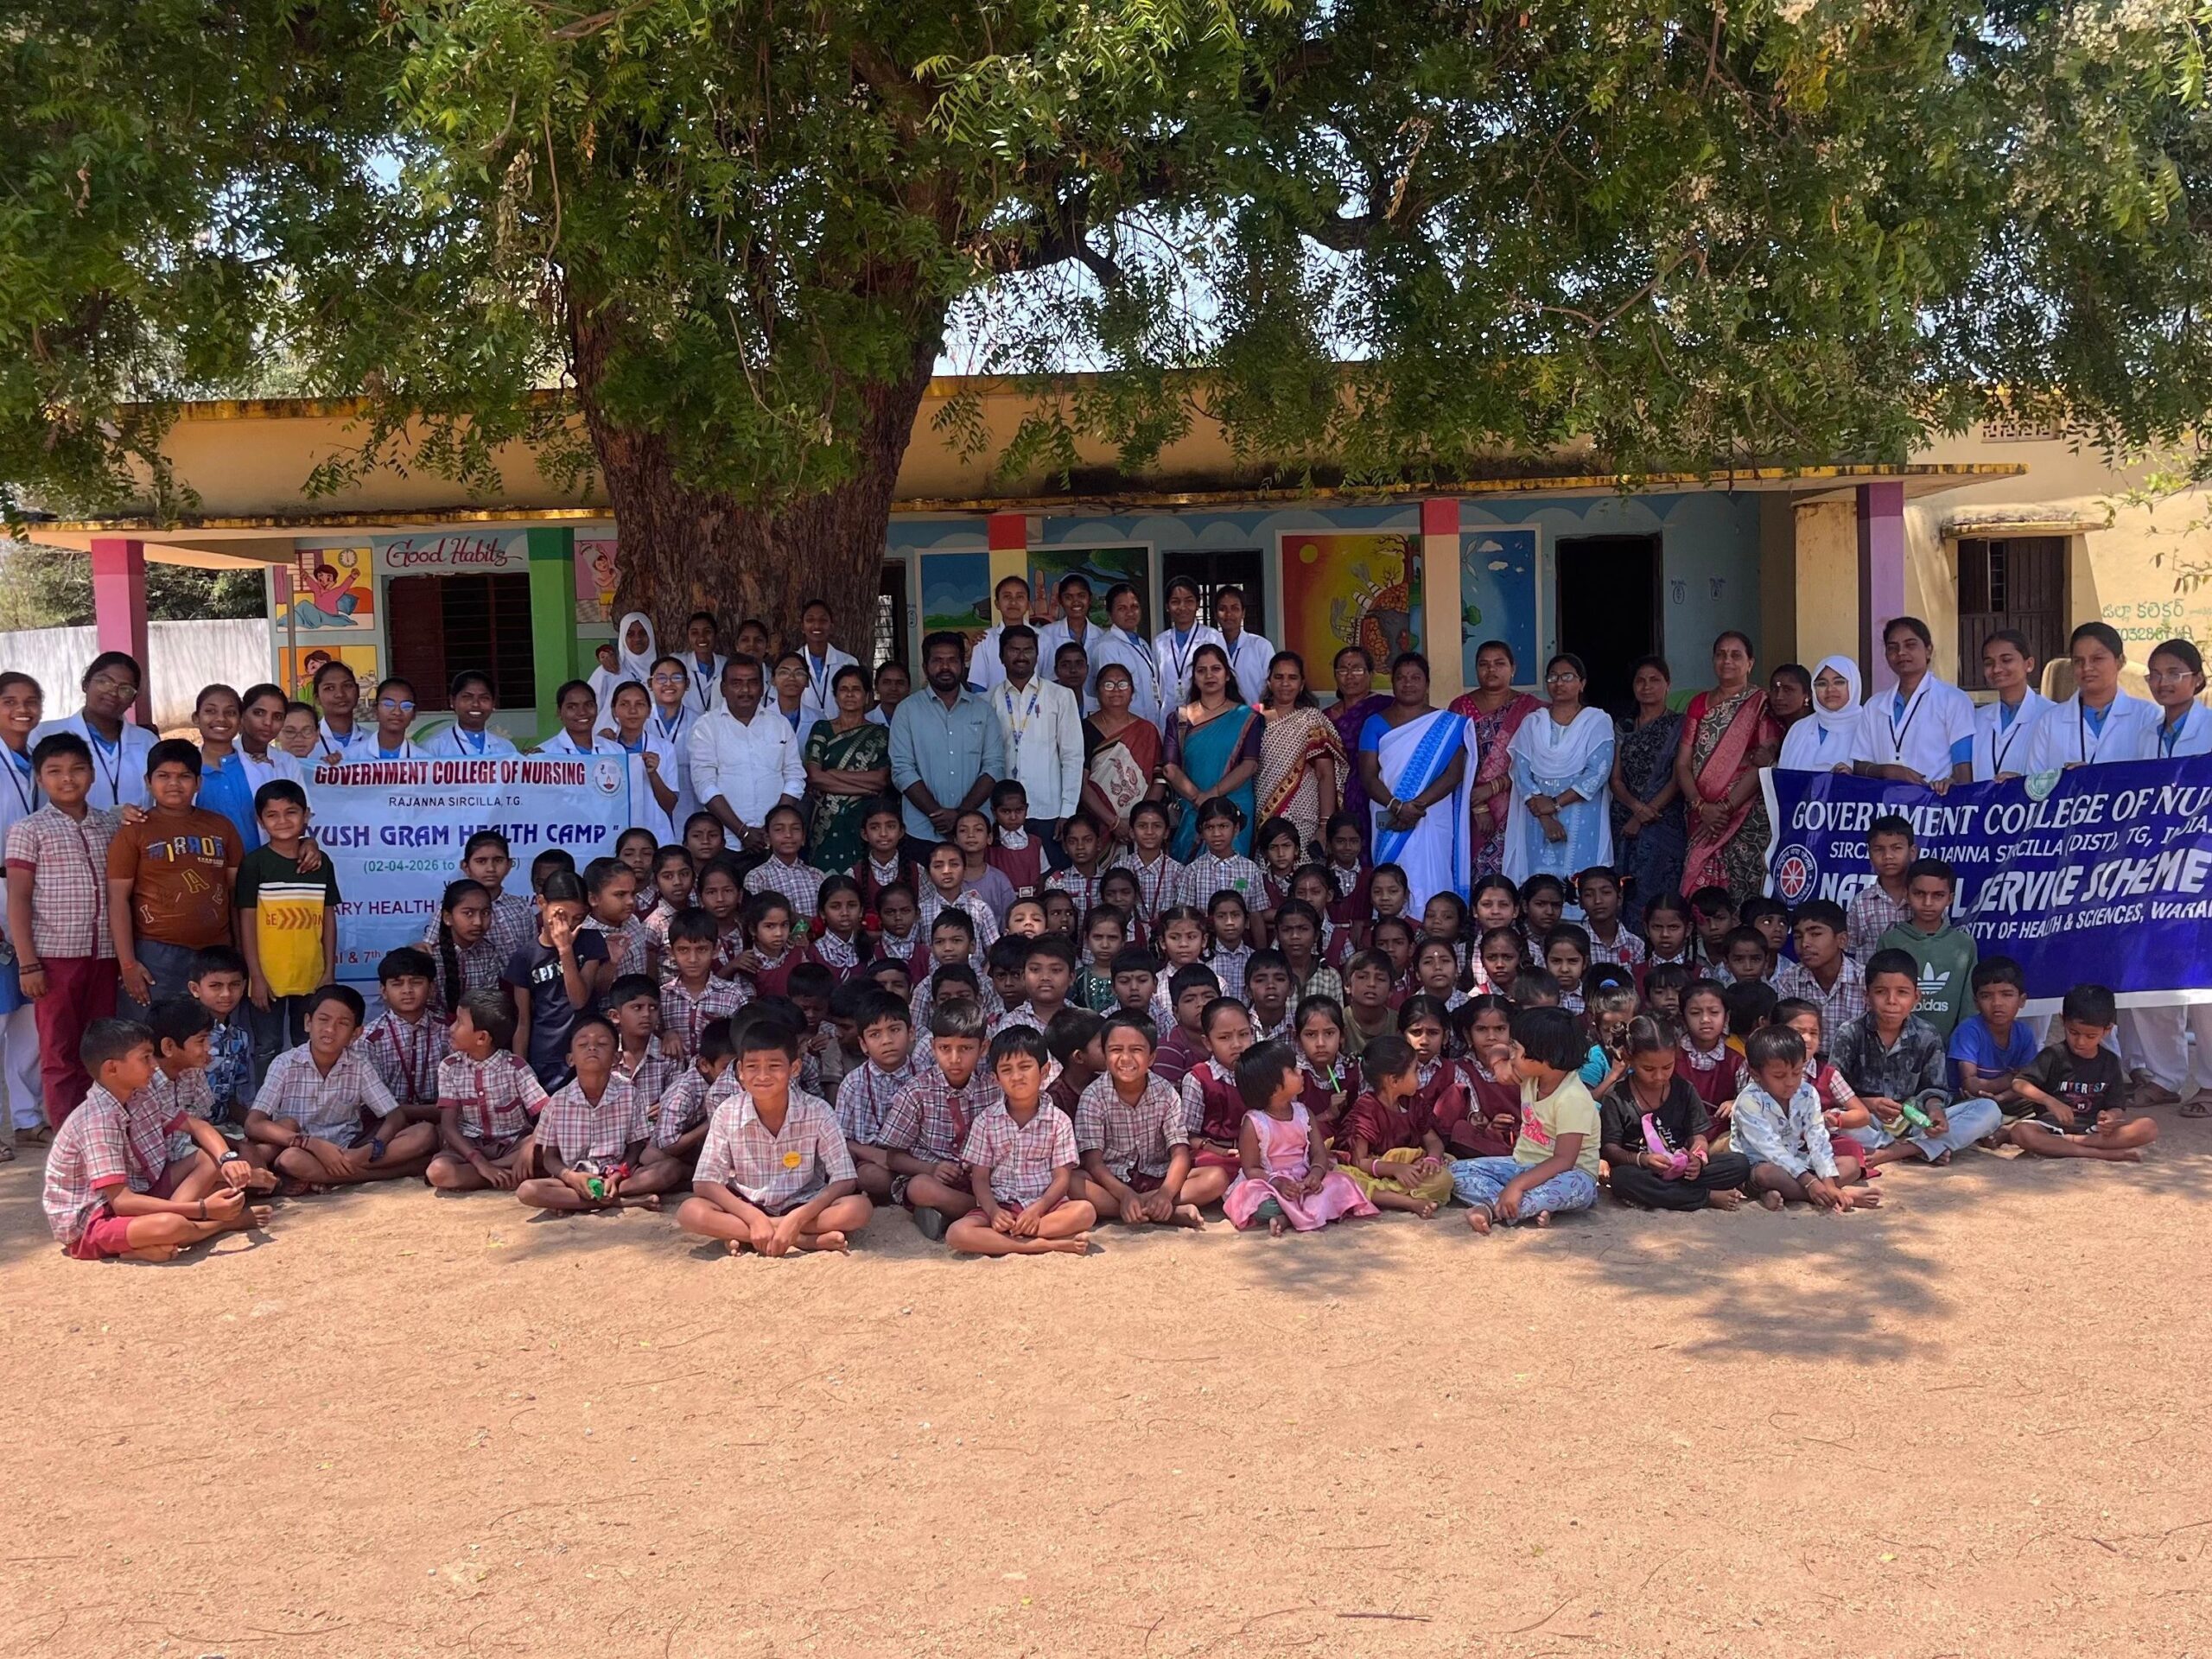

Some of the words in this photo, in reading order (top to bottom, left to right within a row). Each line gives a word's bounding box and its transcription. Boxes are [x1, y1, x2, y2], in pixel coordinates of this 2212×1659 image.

[386, 537, 447, 568] Good
[450, 536, 524, 567] Habits
[315, 760, 429, 785] GOVERNMENT
[432, 760, 497, 785] COLLEGE
[501, 760, 518, 785] OF
[521, 761, 586, 785] NURSING
[389, 797, 445, 807] RAJANNA
[2112, 787, 2154, 822] OF
[379, 825, 449, 849] GRAM
[546, 823, 606, 845] CAMP
[2126, 826, 2153, 847] TG,
[363, 860, 439, 874] (02-04-2026
[442, 861, 455, 871] to
[1971, 865, 2085, 917] SERVICE
[2081, 849, 2212, 902] SCHEME
[368, 900, 435, 915] HEALTH
[1998, 921, 2018, 940] OF
[2063, 913, 2074, 931] &
[2075, 902, 2145, 929] SCIENCES,
[2151, 899, 2212, 919] WARA
[348, 951, 359, 963] &
[364, 950, 381, 963] 7th
